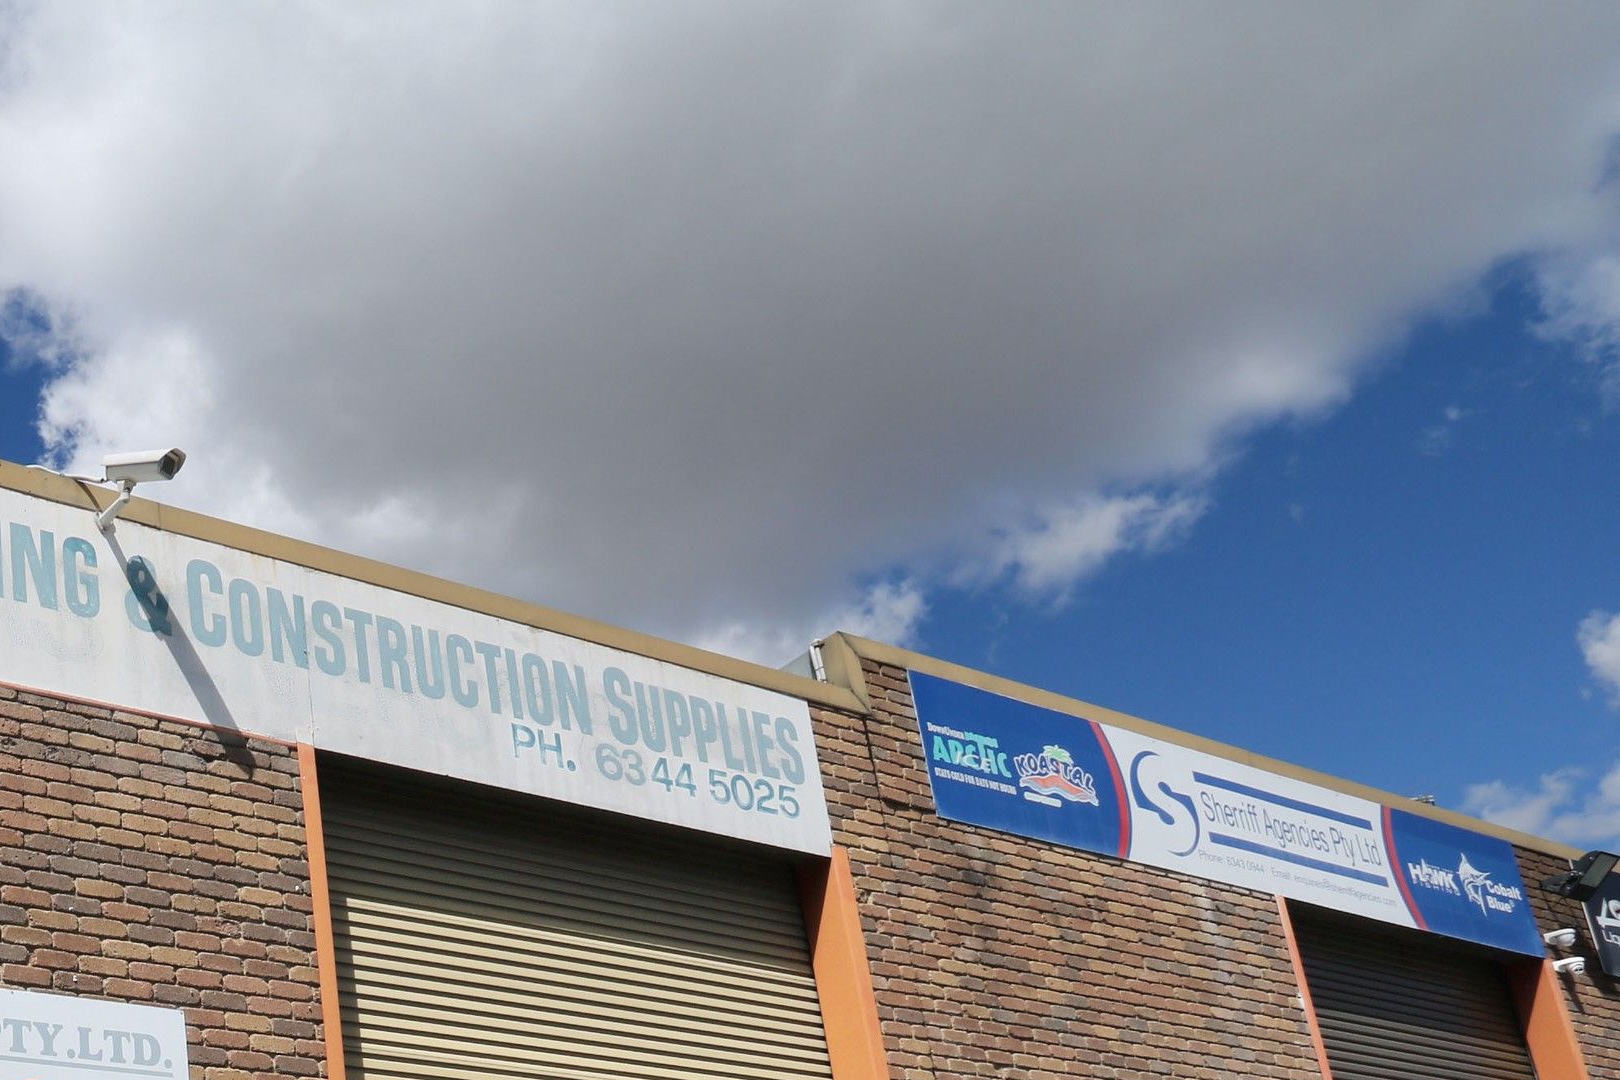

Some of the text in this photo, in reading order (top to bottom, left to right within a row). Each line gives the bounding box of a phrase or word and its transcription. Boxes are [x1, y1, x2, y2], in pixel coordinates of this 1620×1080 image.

[125, 555, 172, 637] &
[186, 558, 592, 735] CONSTRUCTION
[602, 666, 805, 785] SUPPLIES
[510, 722, 800, 818] PH. 6344 5025
[1013, 753, 1097, 795] KOASTAL
[1200, 791, 1381, 867] Sherriff Agencies Pty Ltd
[1486, 880, 1522, 900] Cobalt
